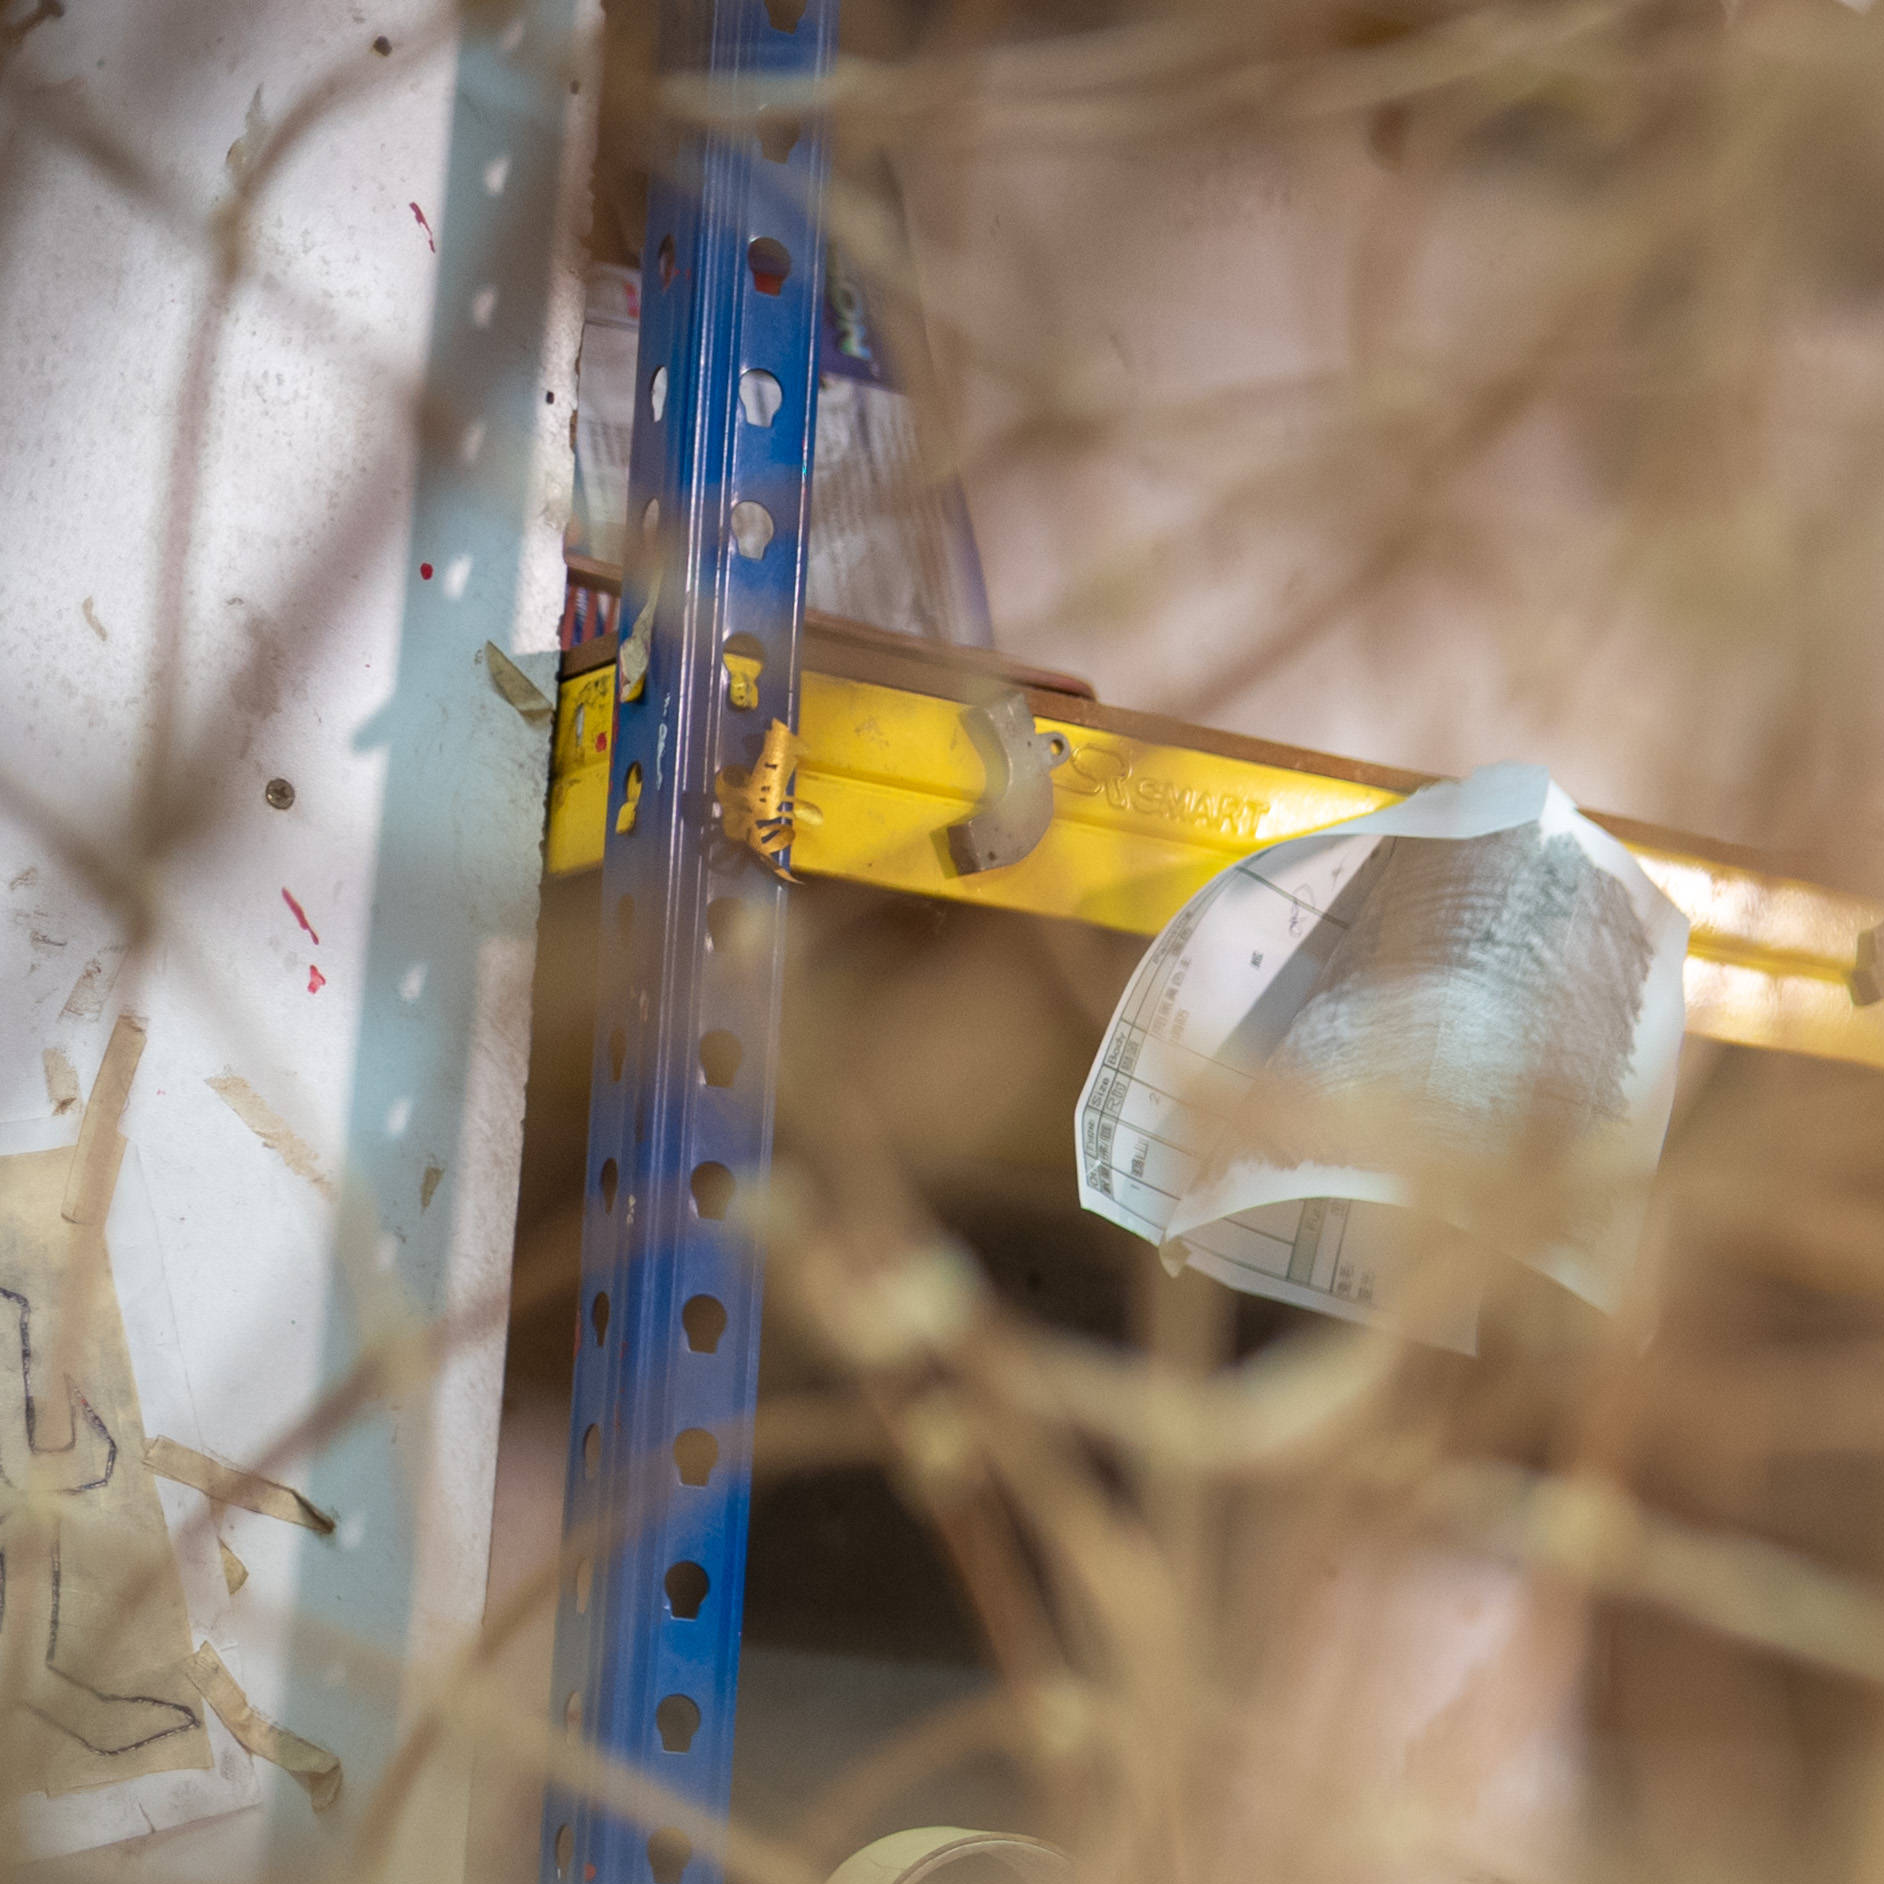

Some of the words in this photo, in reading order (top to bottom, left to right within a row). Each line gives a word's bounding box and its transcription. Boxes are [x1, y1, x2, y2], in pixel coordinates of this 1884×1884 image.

[1134, 777, 1271, 839] SMART
[1091, 1076, 1110, 1108] Size
[1107, 1032, 1126, 1065] Body
